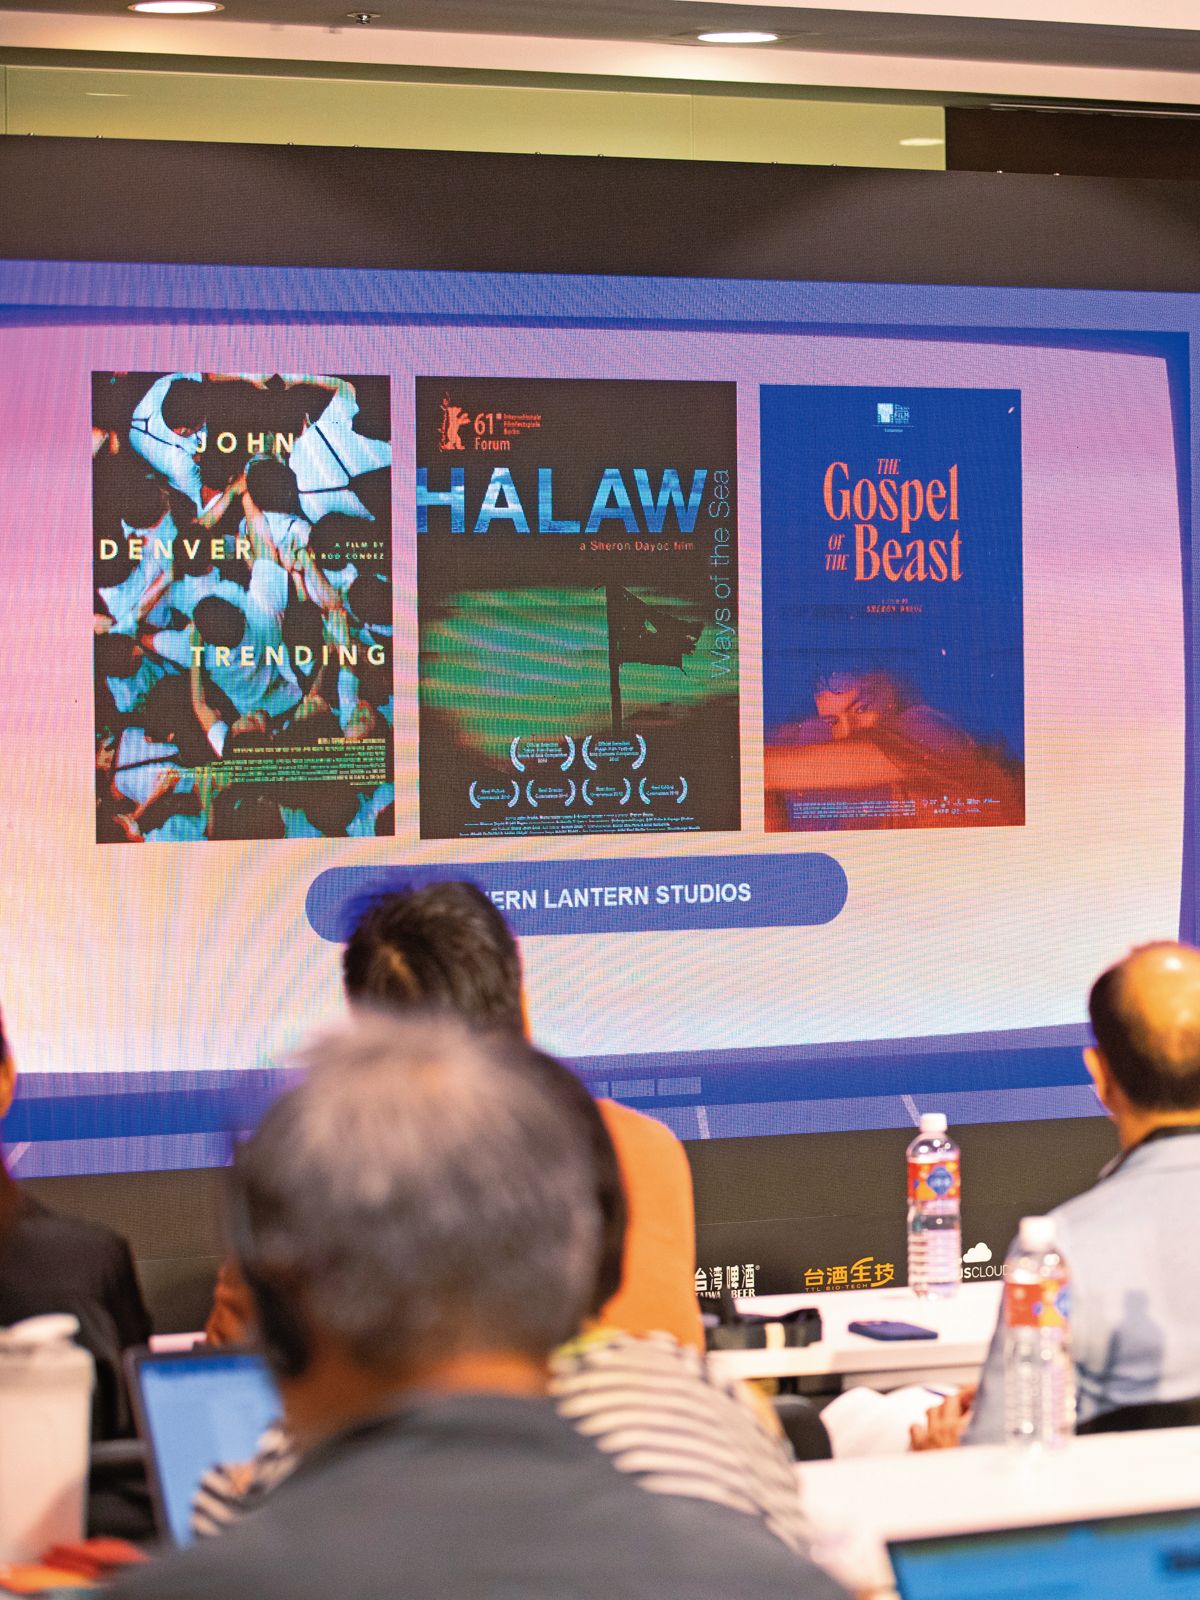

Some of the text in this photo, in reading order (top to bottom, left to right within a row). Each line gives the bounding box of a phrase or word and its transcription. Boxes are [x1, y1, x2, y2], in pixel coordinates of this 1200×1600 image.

[197, 432, 293, 453] JOHN
[475, 438, 511, 451] Forum
[877, 458, 901, 475] THE
[416, 467, 707, 534] HALAW
[823, 461, 959, 533] Gospel
[100, 538, 251, 561] DENVER
[579, 541, 586, 551] a
[854, 523, 963, 583] Beast
[825, 553, 850, 572] THE
[708, 469, 736, 679] Ways of the Sea
[192, 645, 386, 667] TRENDING
[485, 882, 751, 910] ERN LANTERN STUDIOS
[804, 1256, 895, 1288] 台酒生技
[731, 1288, 756, 1298] BEER
